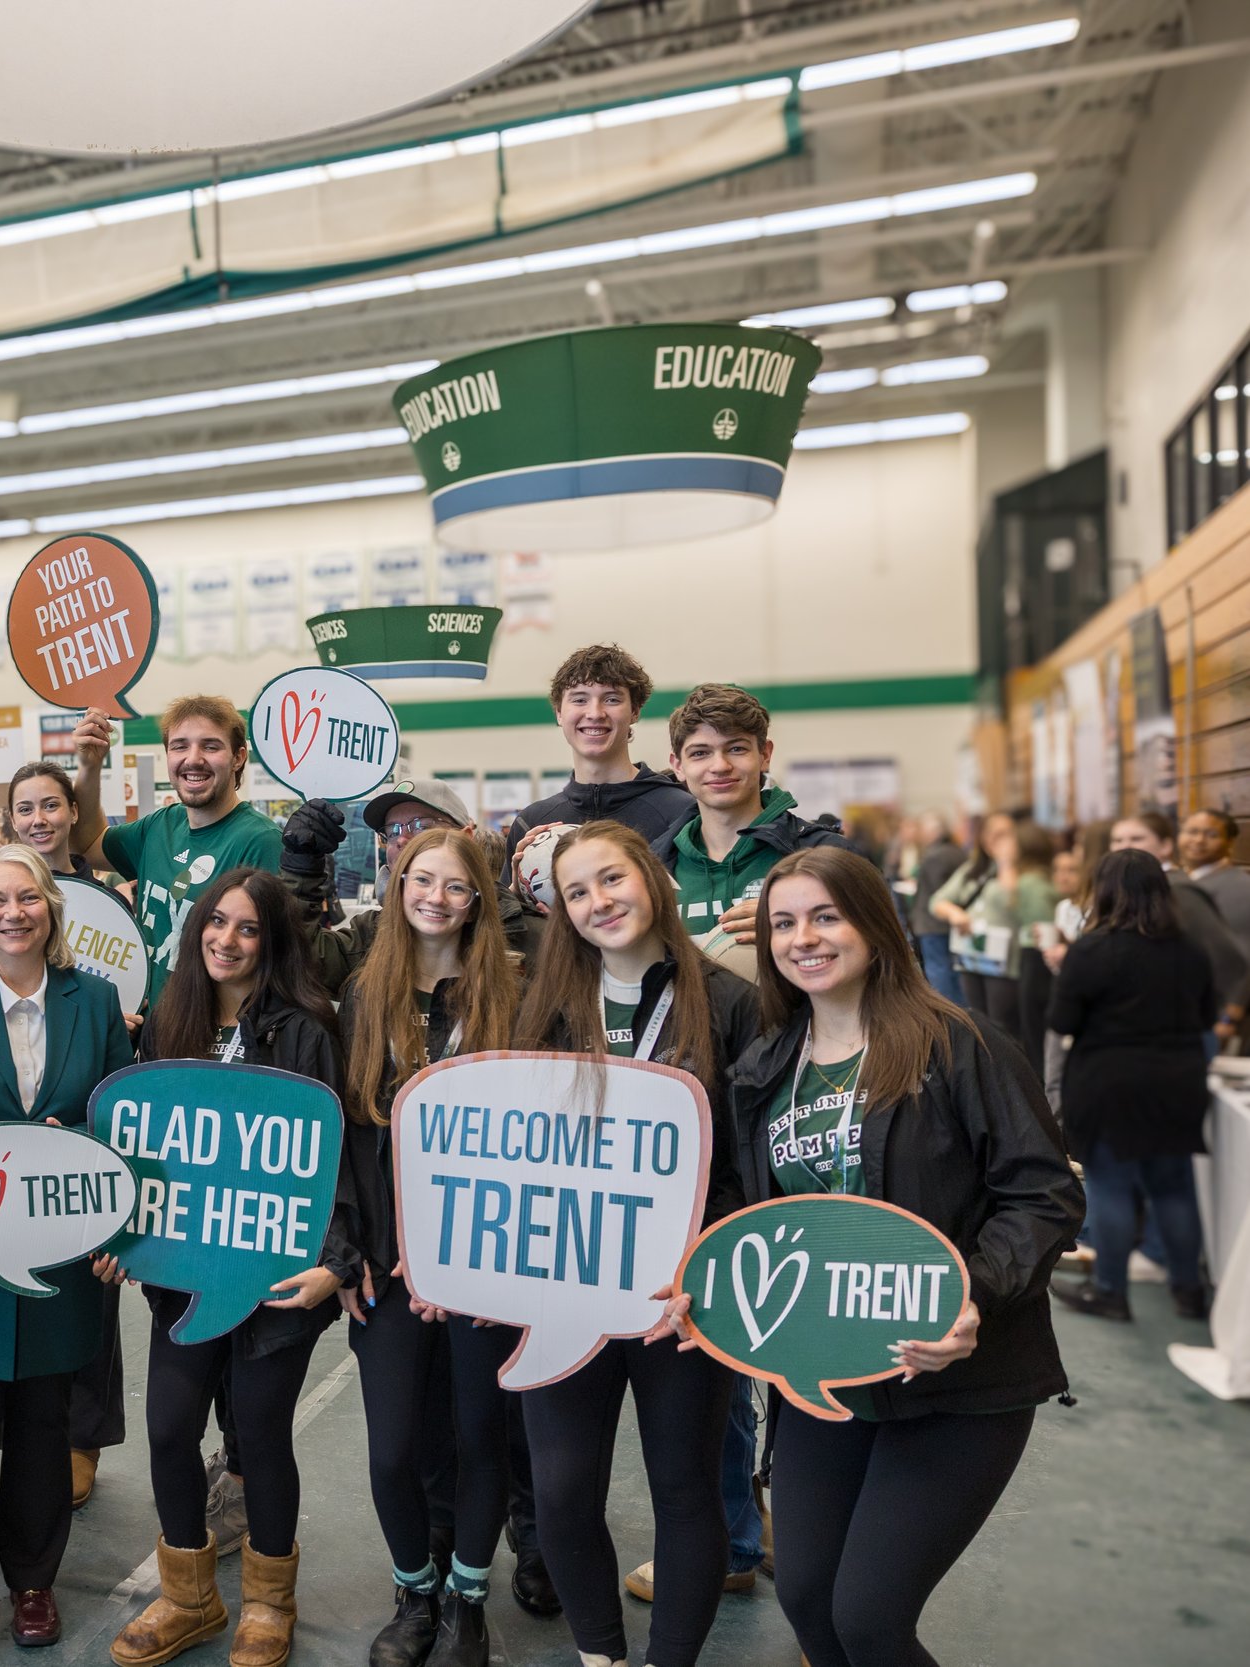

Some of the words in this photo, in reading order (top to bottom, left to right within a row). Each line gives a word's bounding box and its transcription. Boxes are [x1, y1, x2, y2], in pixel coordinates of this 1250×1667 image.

[654, 345, 795, 397] EDUCATION
[36, 546, 94, 596] YOUR
[35, 593, 88, 639] PATH
[87, 576, 116, 610] TO
[427, 613, 484, 634] SCIENCES
[35, 608, 136, 692] TRENT
[263, 705, 272, 742] I
[327, 716, 390, 766] TRENT
[63, 920, 137, 971] ENGE
[606, 1028, 634, 1043] UN
[109, 1100, 221, 1166] GLAD
[234, 1111, 322, 1179] YOU
[418, 1103, 614, 1171] WELCOME
[627, 1118, 680, 1176] TO
[768, 1104, 811, 1141] RENT
[826, 1123, 862, 1156] TE
[20, 1171, 122, 1219] TRENT
[126, 1178, 191, 1240] RE
[201, 1186, 311, 1259] HERE
[431, 1174, 654, 1292] TRENT
[703, 1258, 717, 1310] I
[824, 1261, 950, 1324] TRENT
